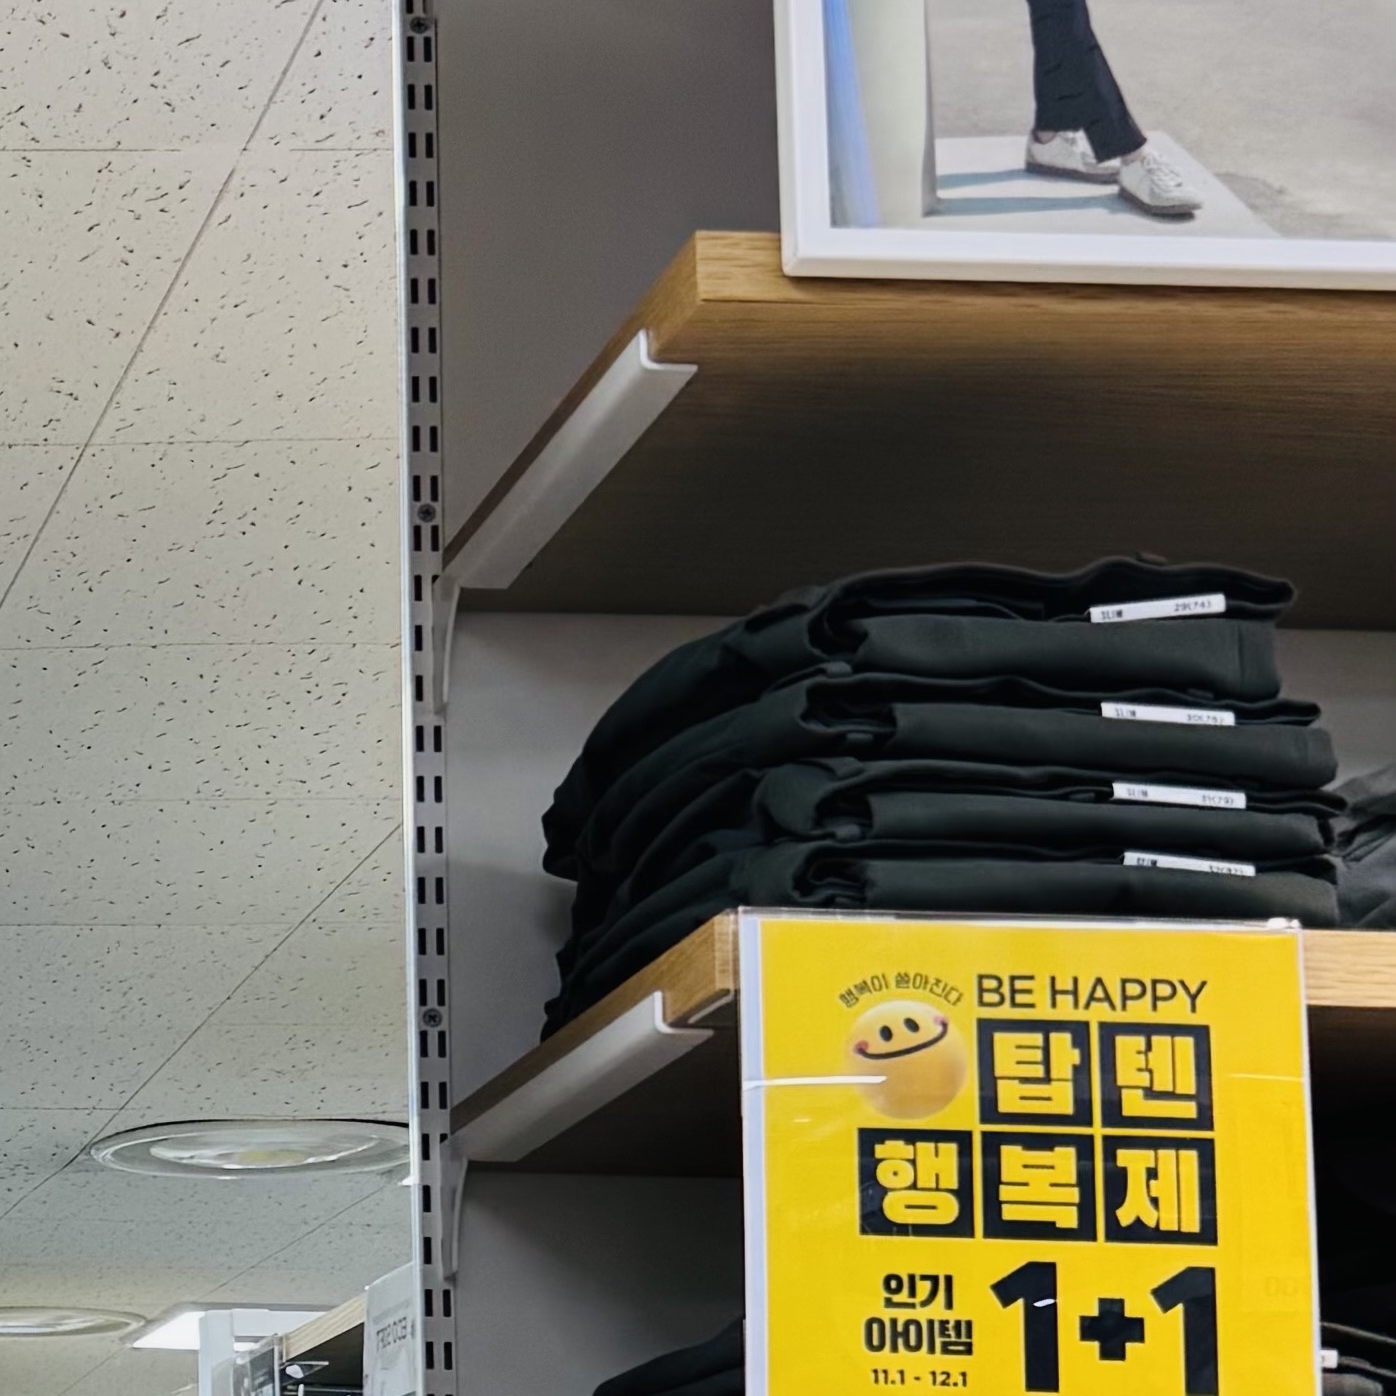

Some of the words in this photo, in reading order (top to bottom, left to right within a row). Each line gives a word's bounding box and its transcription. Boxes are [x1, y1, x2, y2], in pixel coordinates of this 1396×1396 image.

[976, 974, 1038, 1010] BE
[1048, 975, 1208, 1014] HAPPY
[988, 1028, 1201, 1123] 탑텐
[869, 1136, 1204, 1236] 행복제
[882, 1273, 954, 1311] 인기
[864, 1316, 974, 1356] 아이템
[871, 1368, 906, 1386] 11.1
[928, 1370, 968, 1388] 12.1
